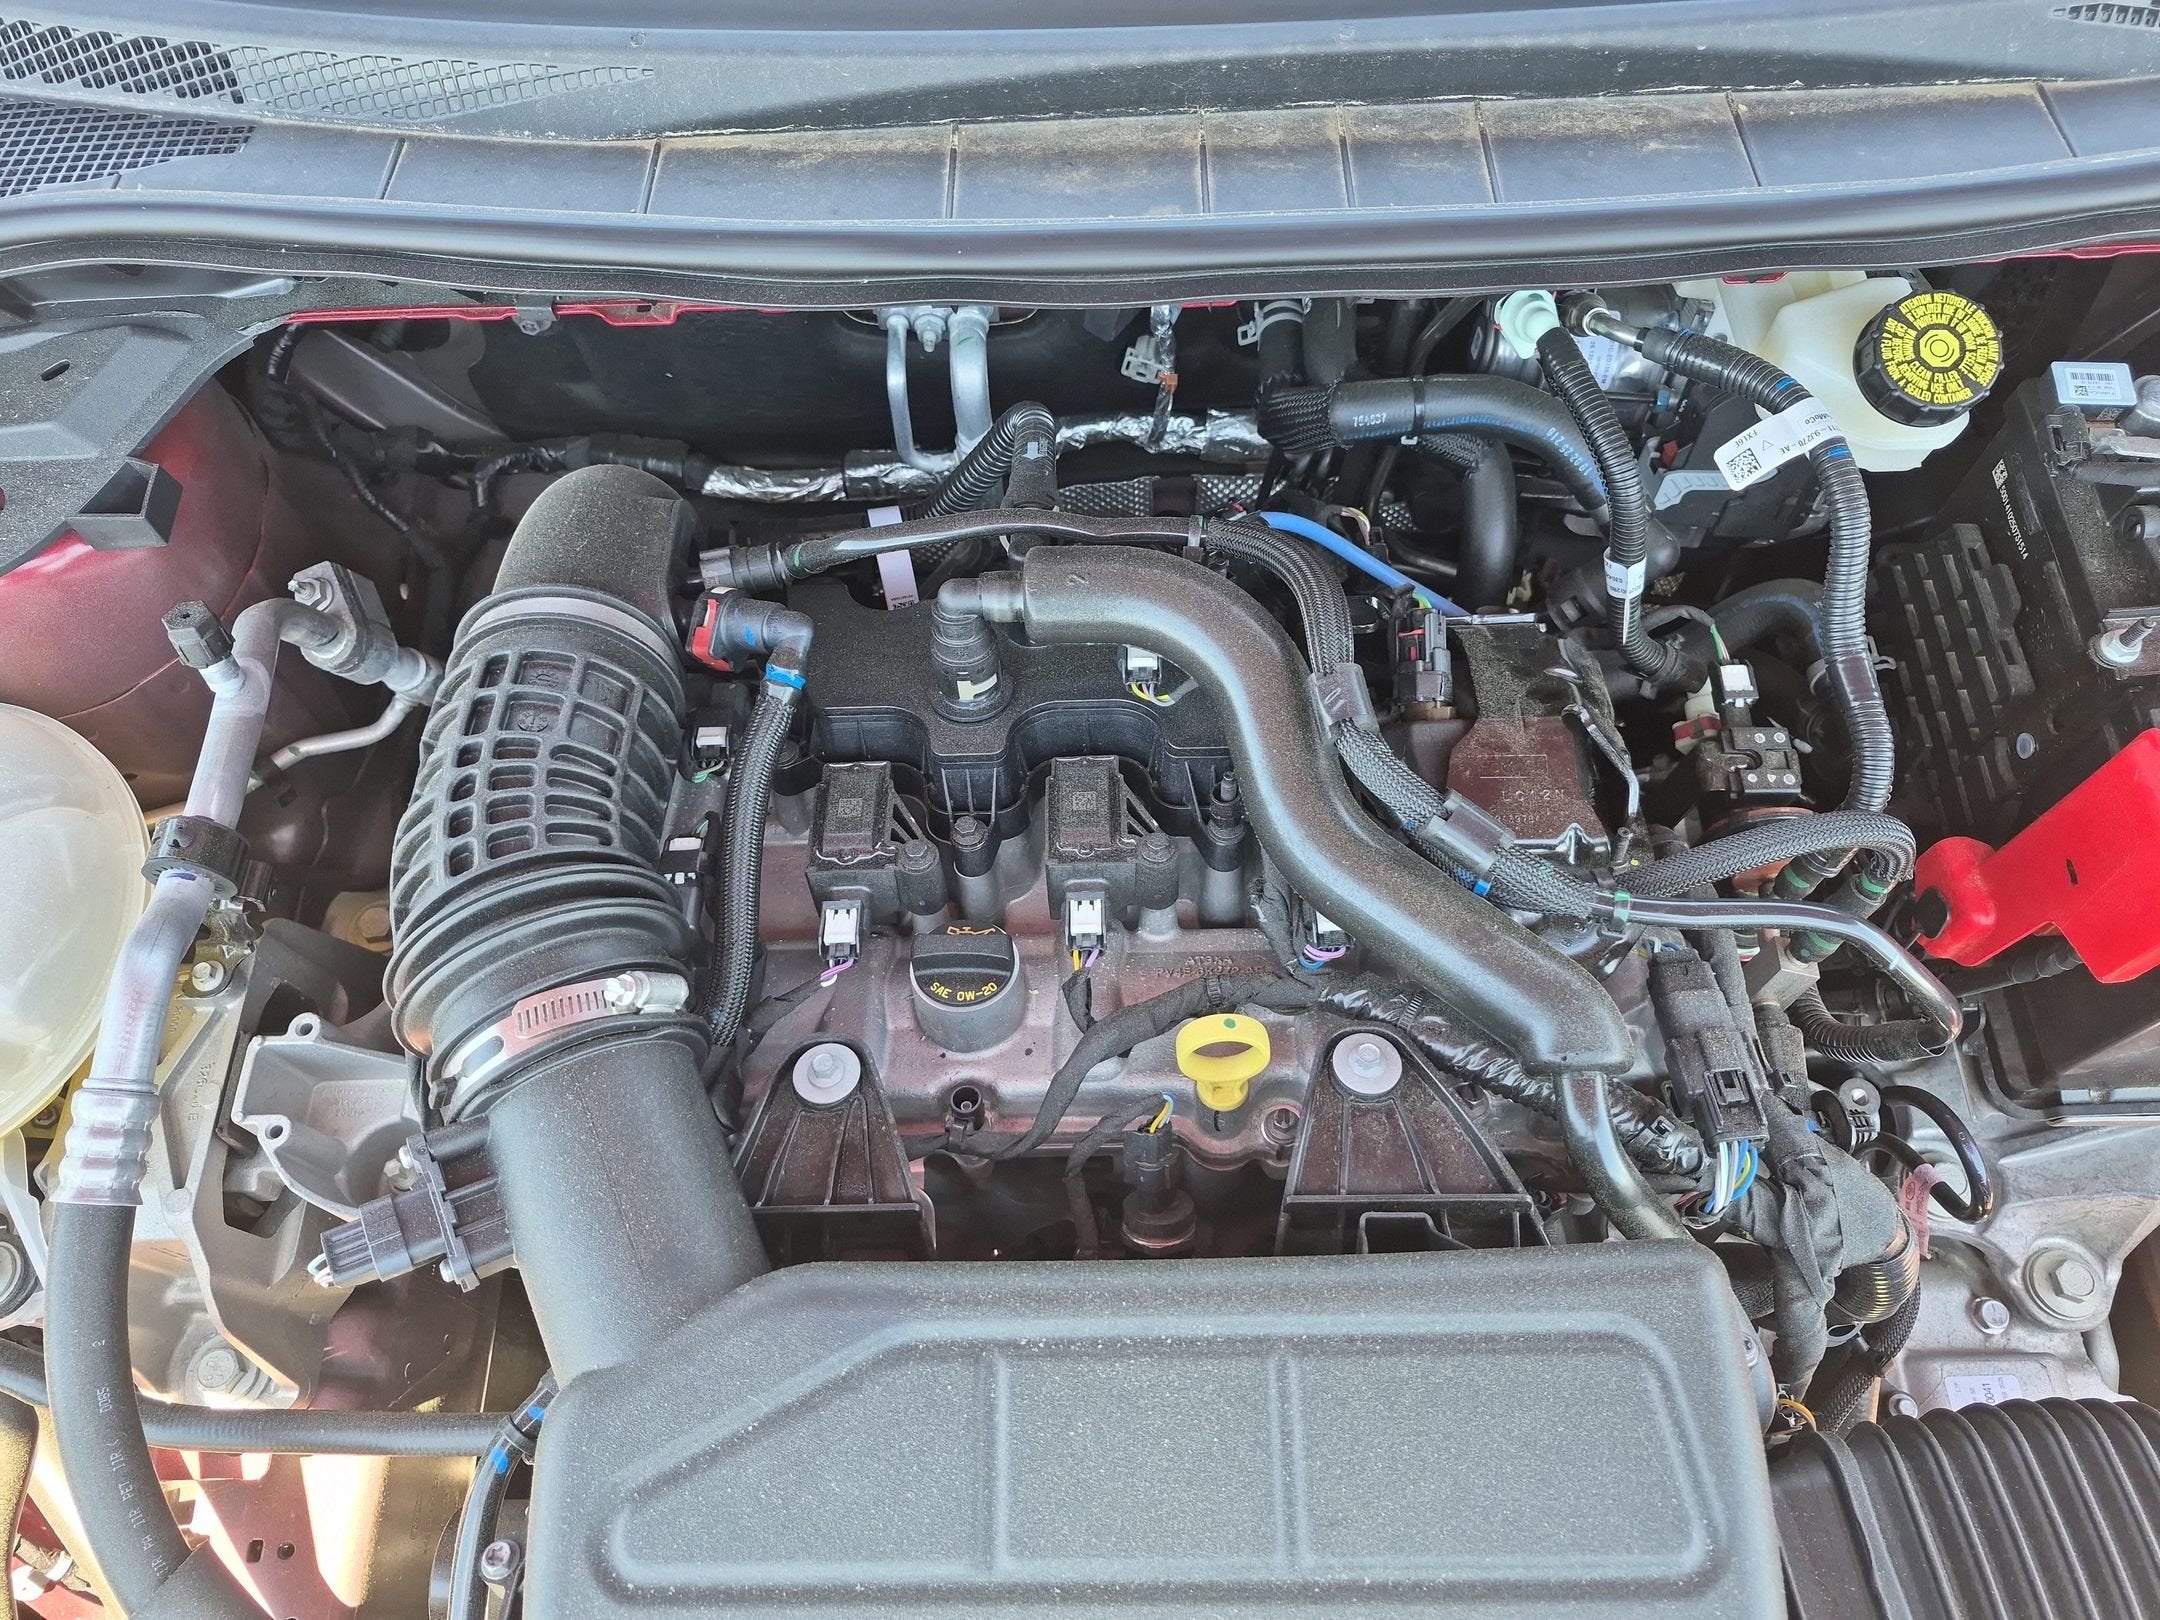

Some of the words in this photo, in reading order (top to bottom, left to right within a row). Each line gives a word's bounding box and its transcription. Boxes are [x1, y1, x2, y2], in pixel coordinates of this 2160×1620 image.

[1899, 294, 1932, 314] ATTENTION
[1934, 293, 1966, 305] NETTOYER
[1966, 303, 1977, 314] LE
[1973, 309, 1996, 338] BOUCHON
[1884, 318, 1897, 332] DOT
[1895, 322, 1908, 336] CAP
[1880, 340, 1892, 359] FLUID
[1885, 362, 1902, 380] FROM
[1898, 363, 1929, 389] REMOVING
[1910, 361, 1932, 379] CLEAN
[1934, 371, 1960, 383] FILLER
[1904, 385, 1931, 402] SEALED
[1931, 383, 1944, 392] USE
[1946, 379, 1964, 392] ONLY
[1934, 388, 1973, 404] CONTAINER
[930, 982, 952, 998] SAE
[956, 982, 998, 1002] 0W-20
